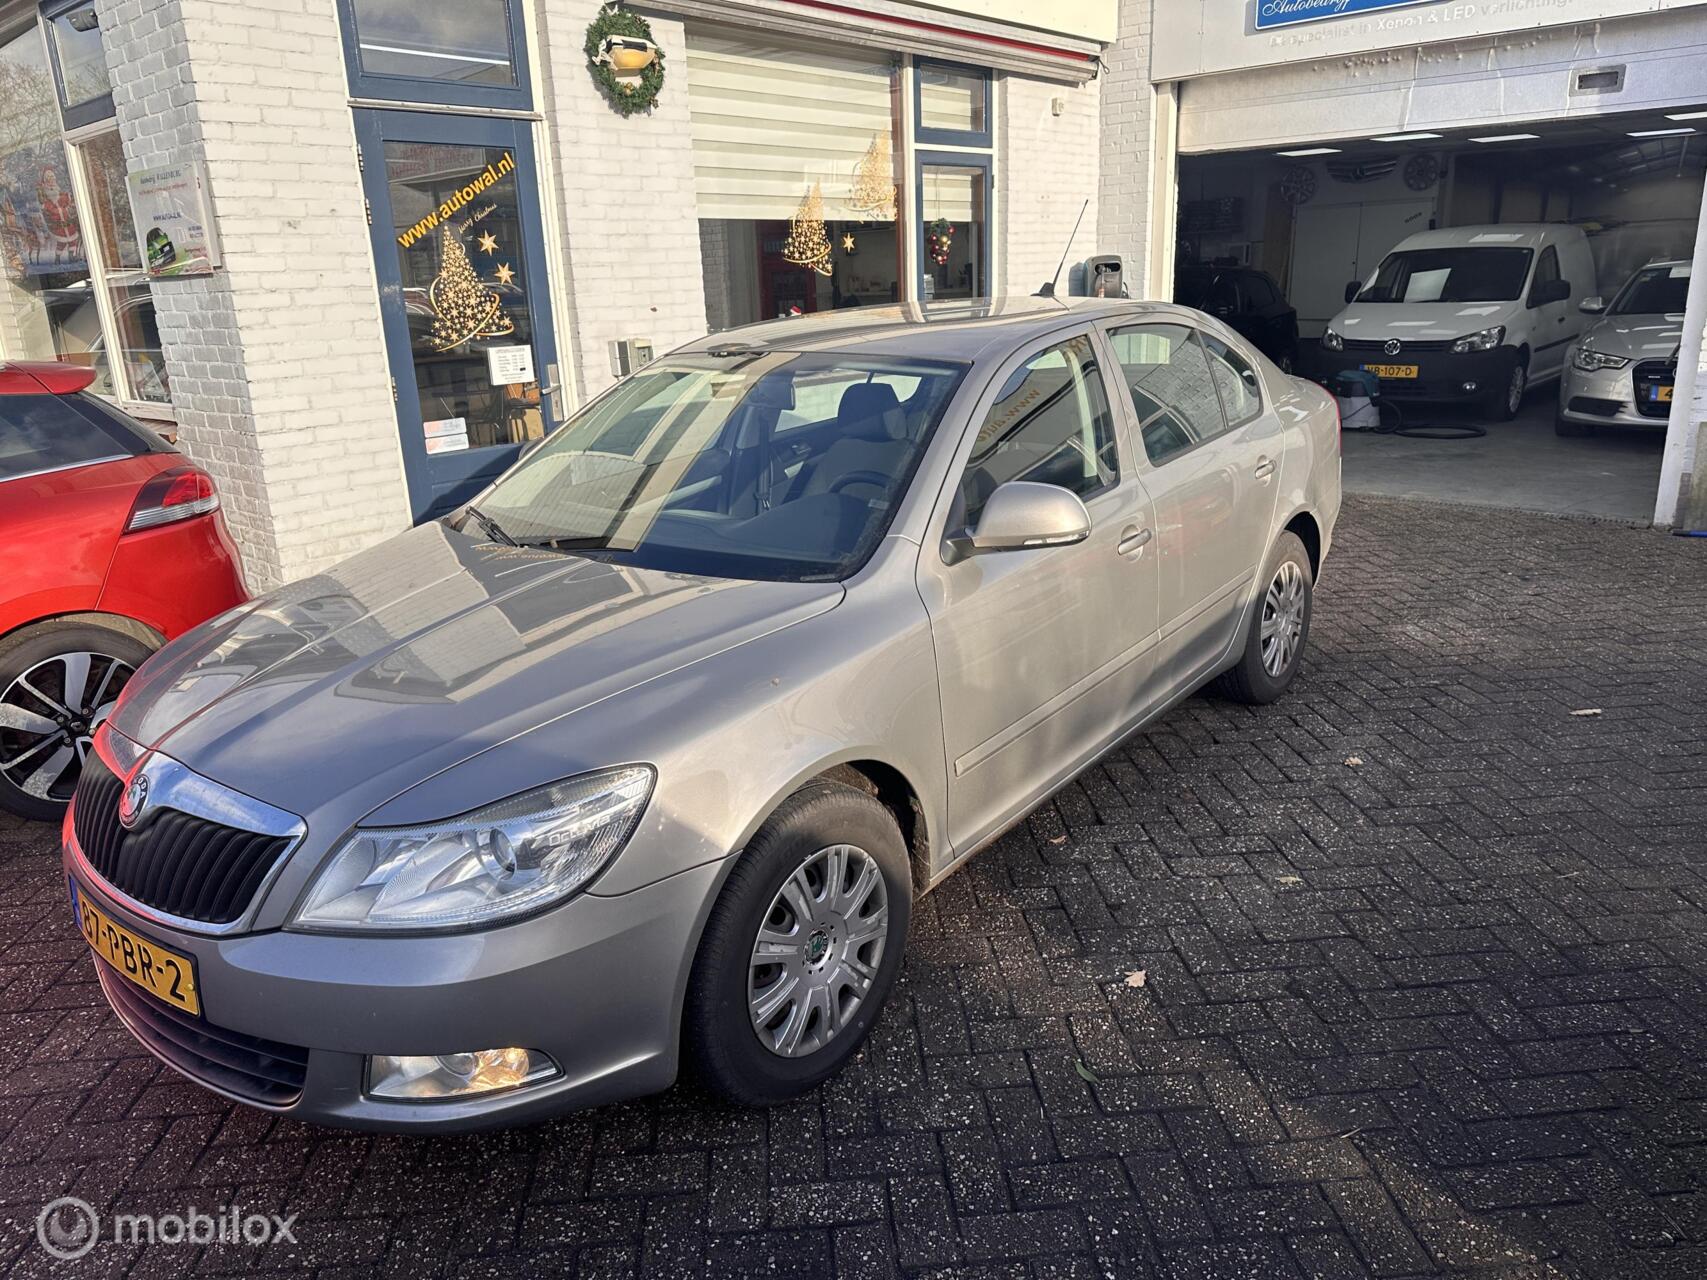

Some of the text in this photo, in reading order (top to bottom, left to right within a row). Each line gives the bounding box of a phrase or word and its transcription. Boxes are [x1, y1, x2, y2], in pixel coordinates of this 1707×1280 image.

[1289, 22, 1355, 46] specialist
[1358, 20, 1373, 34] in
[1377, 15, 1423, 31] Xenon
[1427, 12, 1439, 23] &
[1443, 5, 1476, 22] LED
[398, 152, 515, 249] www.autowal.nl
[82, 900, 186, 1003] 87-PBR-2
